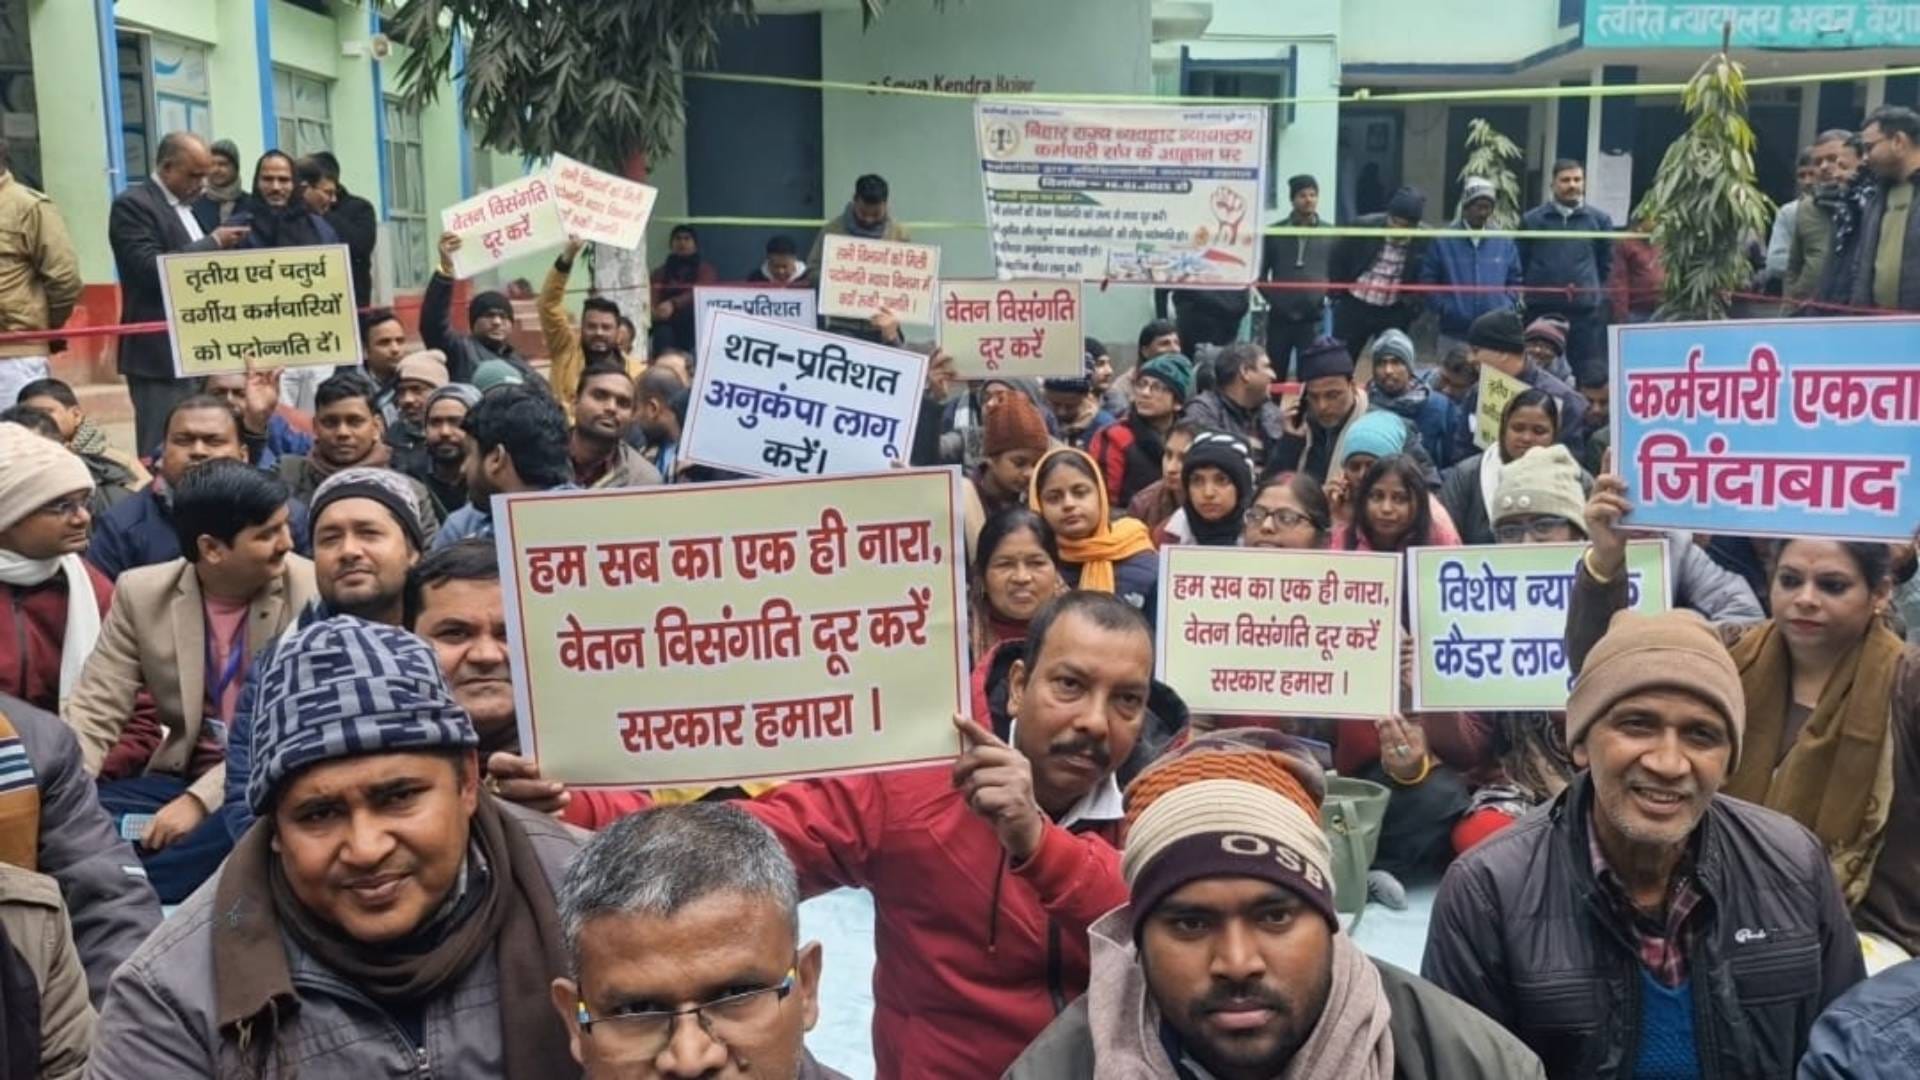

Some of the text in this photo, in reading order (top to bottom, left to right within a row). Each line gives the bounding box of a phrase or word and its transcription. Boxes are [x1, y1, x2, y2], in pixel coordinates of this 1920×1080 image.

[1669, 4, 1779, 38] न्यायालय
[934, 74, 992, 93] Kendra
[1023, 121, 1068, 140] बिहार
[1073, 127, 1111, 141] राज्य
[1035, 142, 1098, 159] कर्मचारी
[1135, 144, 1153, 160] के
[1220, 148, 1242, 161] पर
[453, 179, 549, 231] वेतन विसंगति
[483, 230, 504, 259] दूर
[506, 213, 532, 240] करें
[184, 255, 326, 293] तृतीय एवं चतुर्थ
[179, 293, 343, 323] वर्गीय कर्मचारियों
[945, 289, 1075, 323] वेतन विसंगति
[193, 338, 221, 361] को
[227, 333, 310, 359] पदोन्नति
[724, 334, 902, 395] शत-प्रतिशत
[979, 328, 1045, 370] दूर करें
[1628, 348, 1920, 424] कर्मचारी एकता
[705, 380, 900, 459] अनुकंपा लागू
[762, 437, 827, 474] करें।
[1637, 434, 1905, 511] जिंदाबाद
[526, 508, 942, 594] हम सब का एक ही नारा,
[1173, 570, 1389, 607] हम सब का एक ही नारा,
[1439, 561, 1517, 611] विशेष
[557, 588, 931, 676] वेतन विसंगति दूर करें
[1184, 612, 1381, 661] वेतन विसंगति दूर करें
[1433, 623, 1504, 679] कैडर
[1210, 669, 1276, 692] सरकार
[1279, 671, 1333, 696] हमारा
[617, 704, 744, 753] सरकार
[752, 694, 854, 748] हमारा
